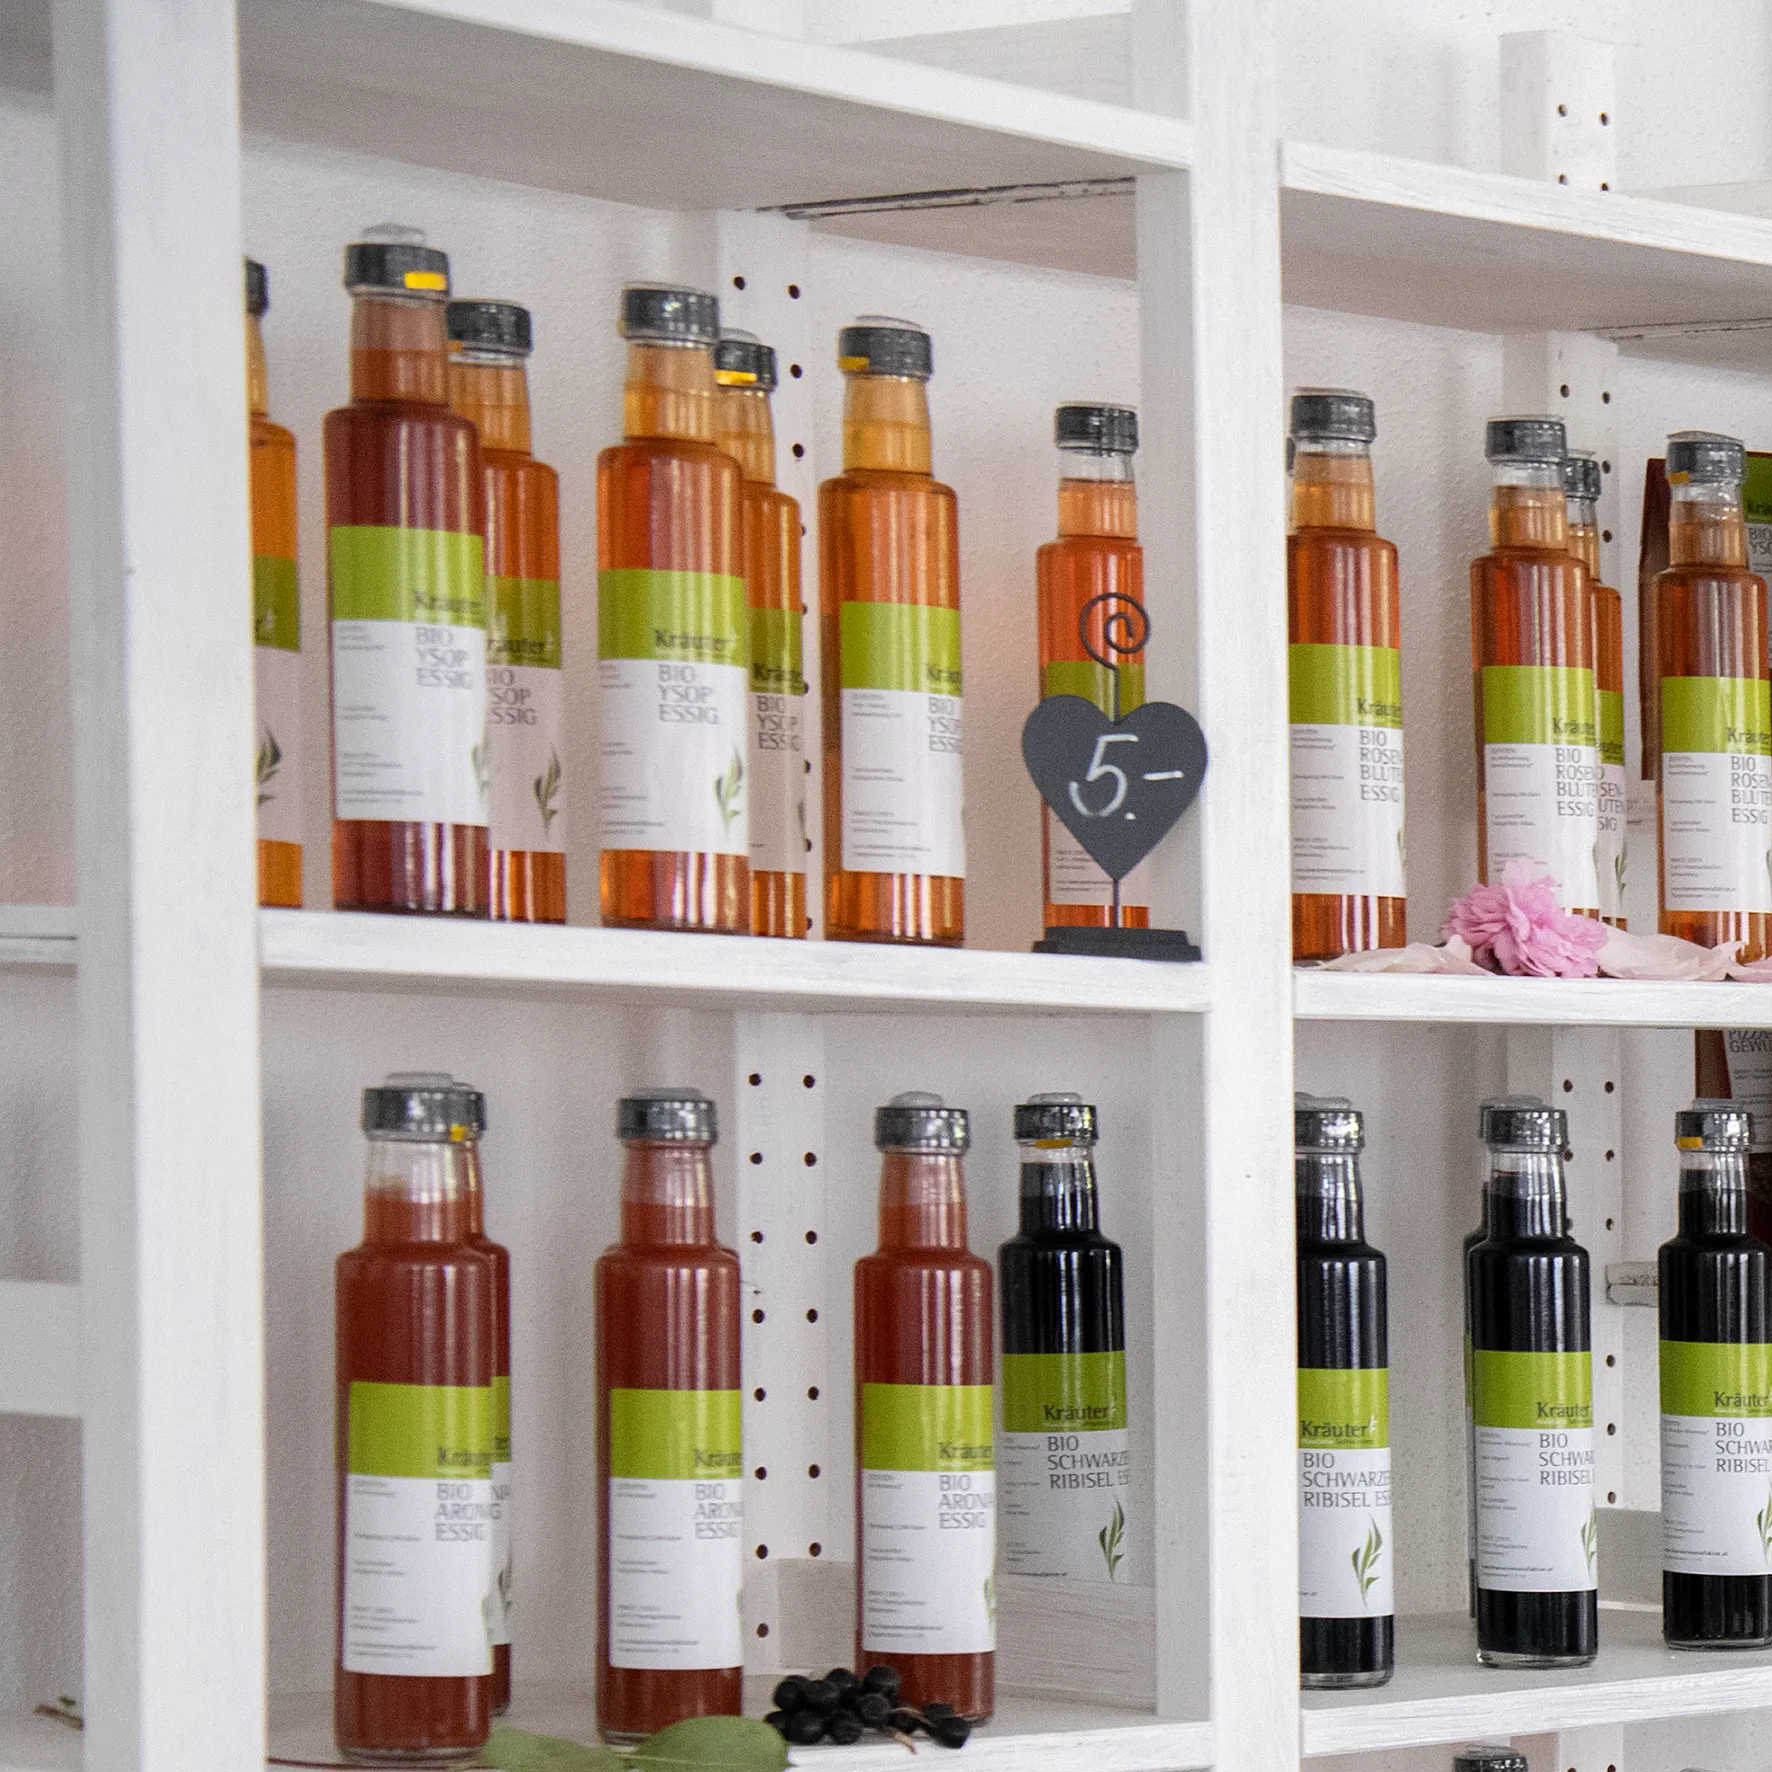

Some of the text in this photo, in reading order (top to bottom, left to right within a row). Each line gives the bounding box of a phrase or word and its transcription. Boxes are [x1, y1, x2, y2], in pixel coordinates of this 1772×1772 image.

[658, 664, 696, 683] BIO
[490, 688, 531, 705] SOP
[659, 685, 714, 704] YSOP
[490, 707, 538, 726] SSIG
[660, 704, 719, 725] ESSIG
[1359, 730, 1388, 747] BIO
[1555, 748, 1582, 764] BIO
[1731, 756, 1756, 772] BIO
[1557, 800, 1595, 817] ESSIG
[1731, 808, 1769, 825] ESSIG
[1714, 1391, 1768, 1409] Kräuter
[1043, 1404, 1109, 1424] Kräuter
[1301, 1420, 1369, 1440] Kräuter
[1716, 1422, 1745, 1438] BIO
[1047, 1436, 1080, 1453] BIO
[1539, 1433, 1569, 1450] BIO
[1303, 1452, 1335, 1469] BIO
[1716, 1457, 1770, 1475] RIBISEL
[939, 1475, 971, 1492] BIO
[1049, 1471, 1115, 1490] RIBISEL
[695, 1483, 725, 1500] BIO
[1303, 1489, 1372, 1508] RIBISEL
[939, 1511, 987, 1530] ESSIG
